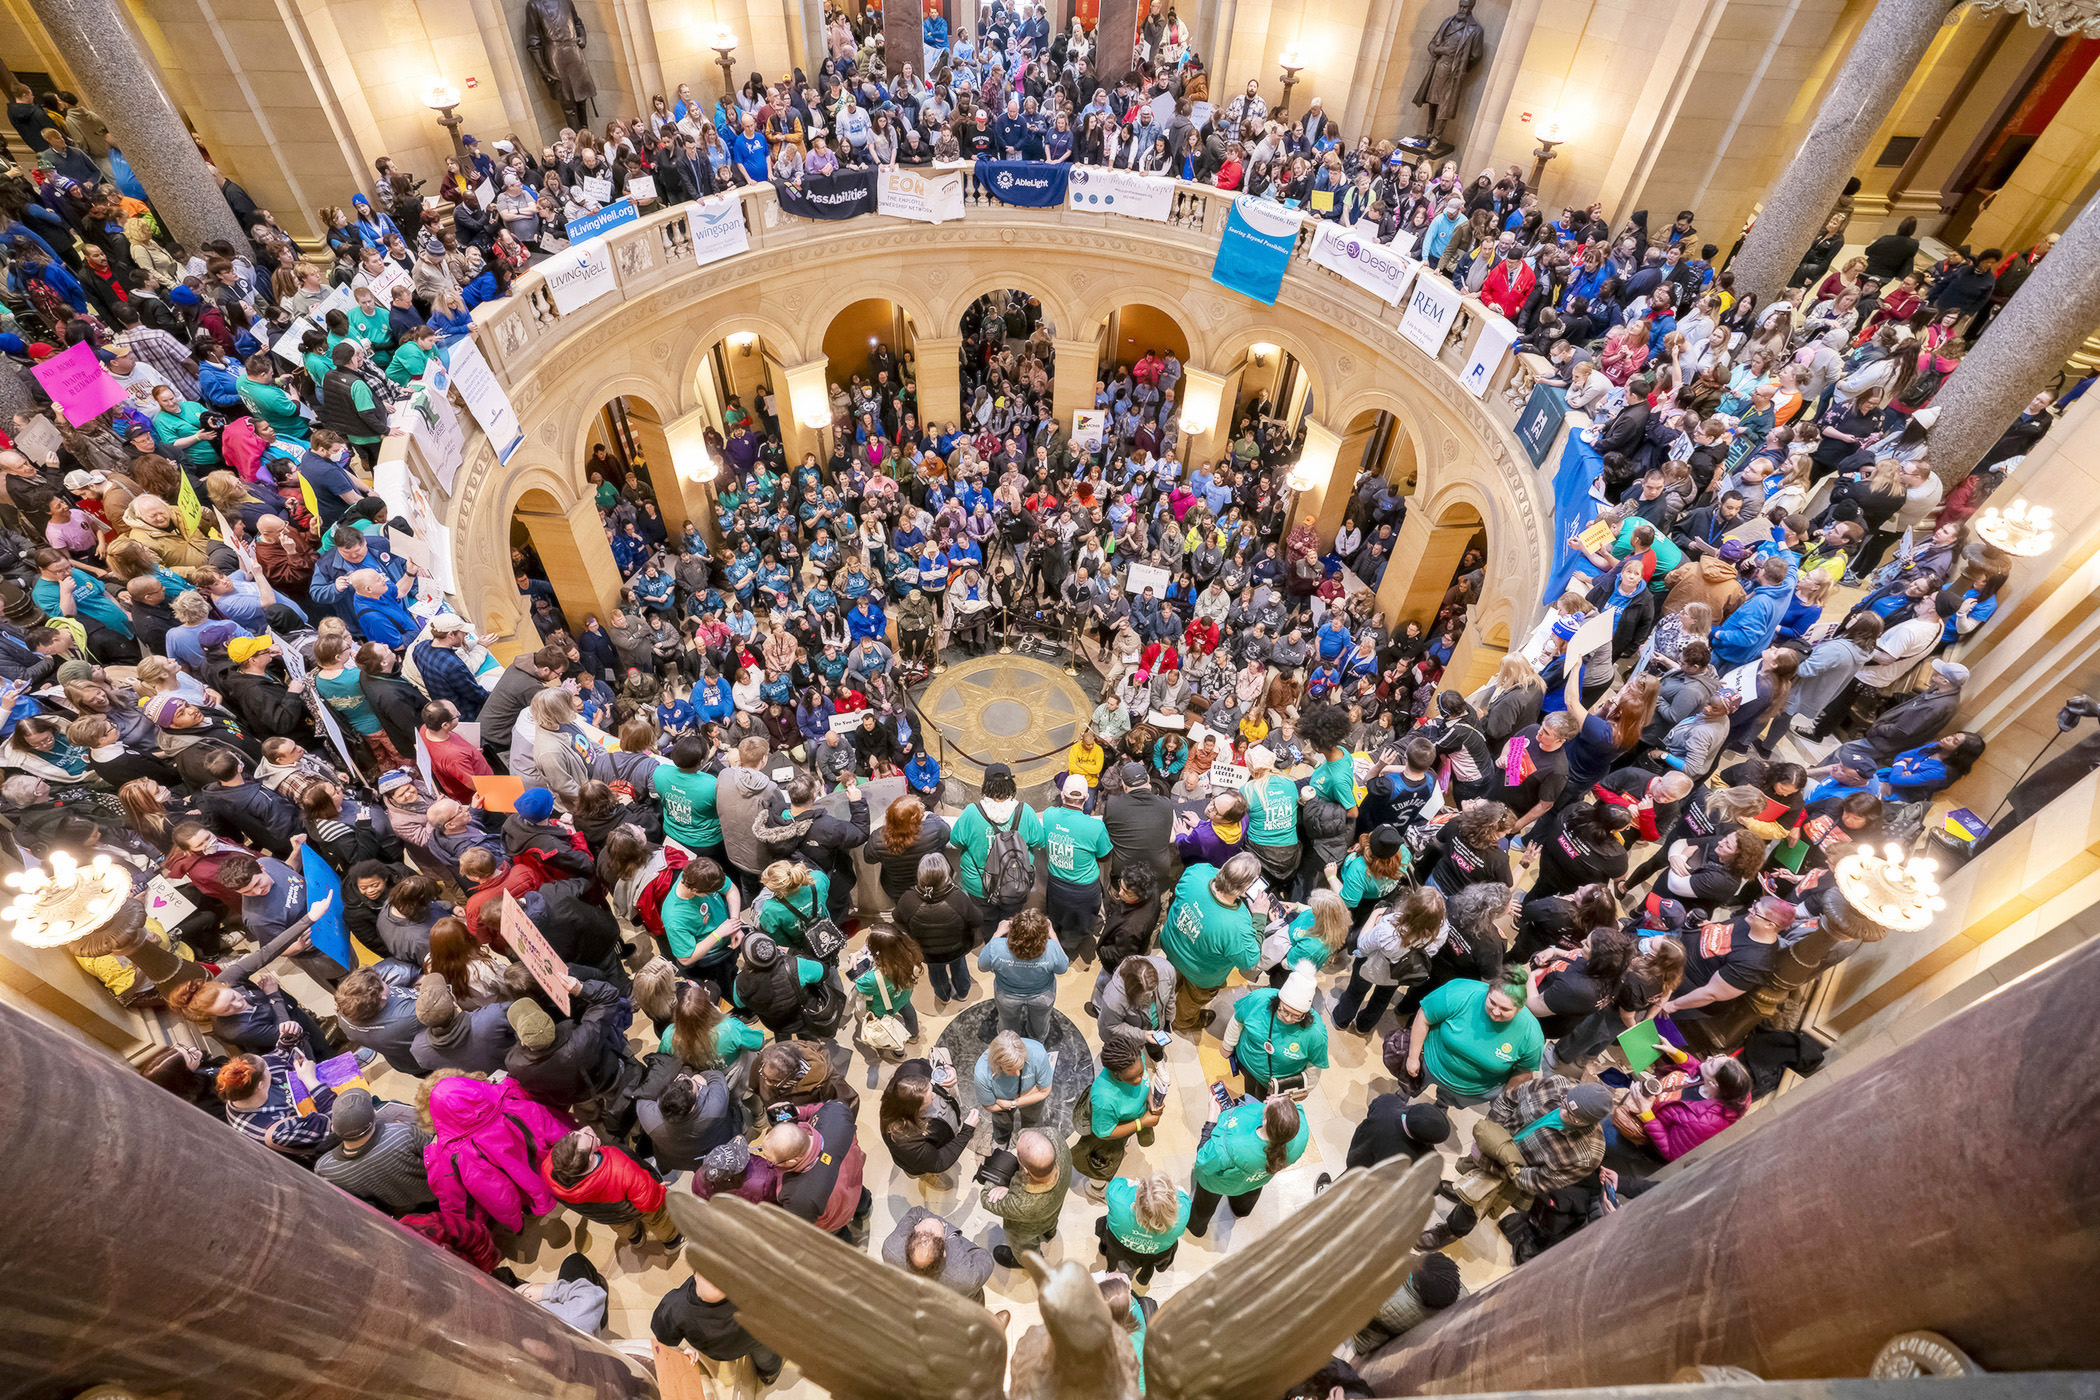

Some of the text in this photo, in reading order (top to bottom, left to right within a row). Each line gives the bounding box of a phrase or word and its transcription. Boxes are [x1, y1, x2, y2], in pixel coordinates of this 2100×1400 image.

[889, 175, 924, 196] EON
[1014, 178, 1049, 189] AbleLight
[805, 187, 868, 205] PossAbilities
[909, 205, 933, 213] NETWORK
[569, 204, 634, 239] #LivingWell.org
[695, 218, 741, 241] wingspan
[1325, 228, 1405, 280] Life By Design
[550, 267, 582, 289] LIVING
[1413, 290, 1446, 324] REM
[56, 358, 76, 373] MORE
[1213, 764, 1235, 773] EXPAND
[1215, 770, 1235, 778] ACCESS
[665, 800, 692, 815] TEAM
[1265, 804, 1293, 822] TEAM
[1687, 815, 1701, 836] MORA
[1048, 839, 1075, 858] TEAM
[1557, 835, 1576, 858] MORA
[151, 880, 183, 908] We Are
[1121, 1235, 1159, 1254] TEAM
